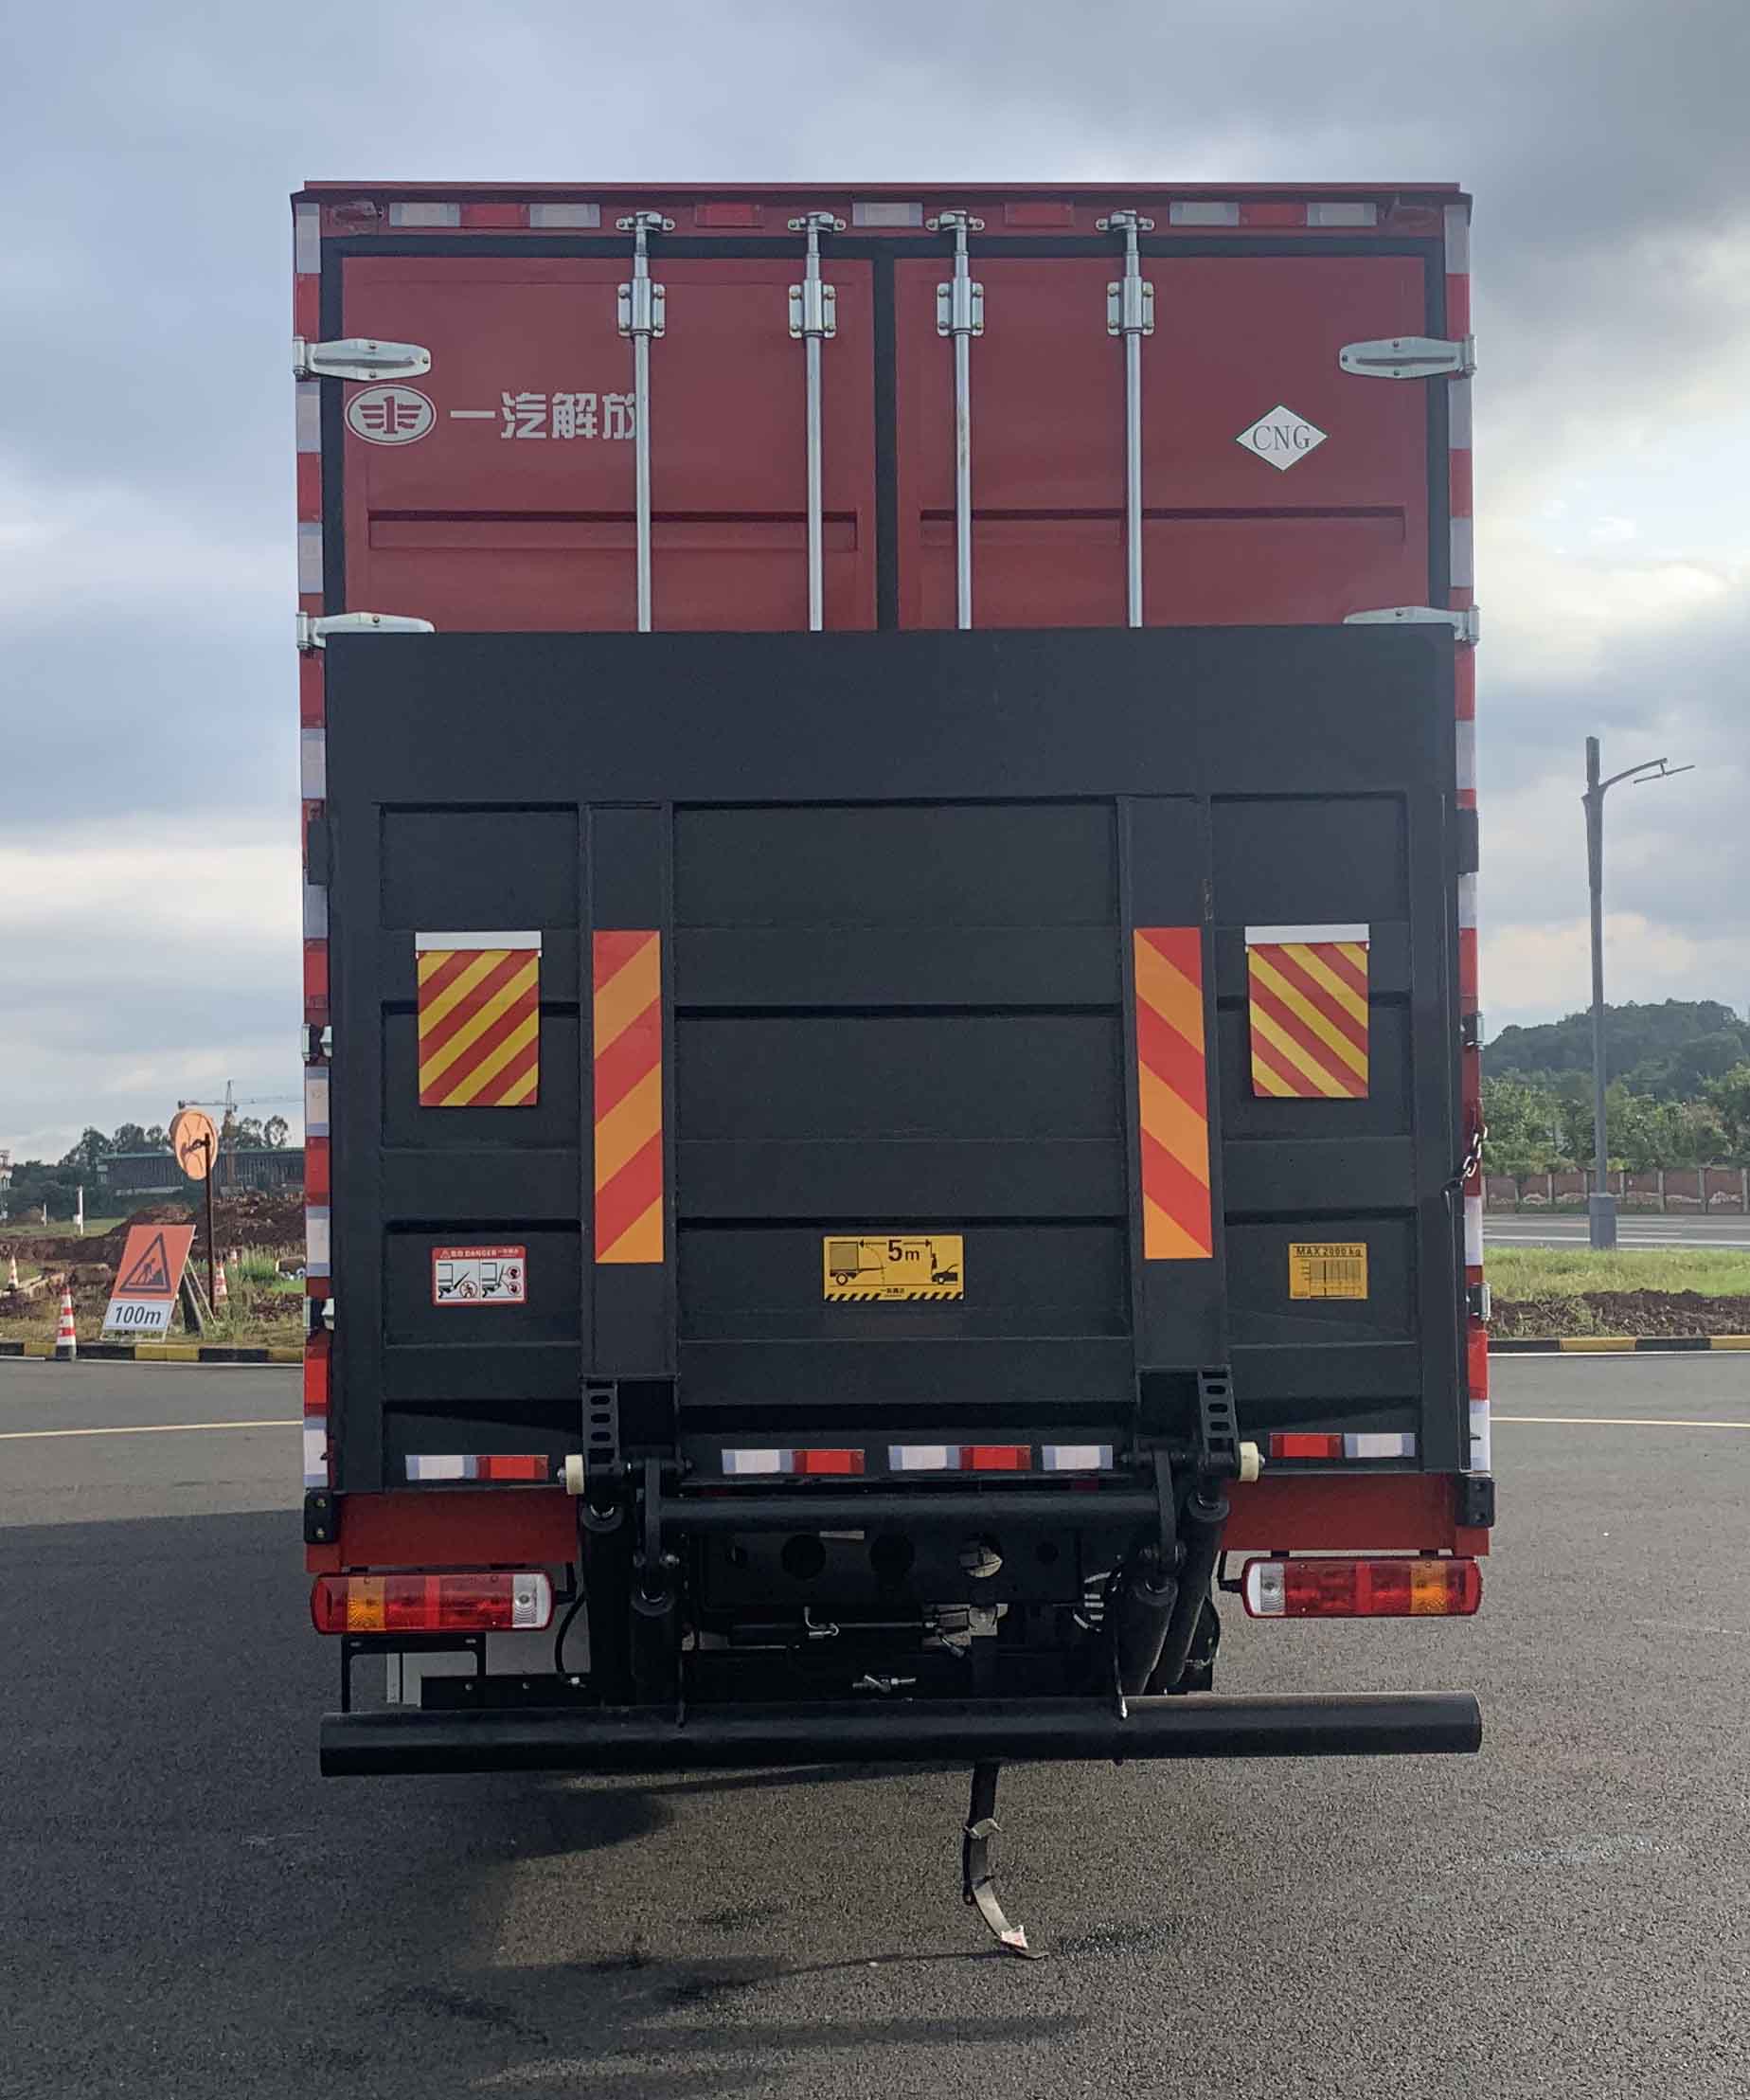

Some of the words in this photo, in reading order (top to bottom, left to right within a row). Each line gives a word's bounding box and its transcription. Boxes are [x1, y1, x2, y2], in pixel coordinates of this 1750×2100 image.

[1253, 425, 1311, 451] CNG
[888, 1239, 920, 1262] 5m
[115, 1305, 161, 1325] 100m
